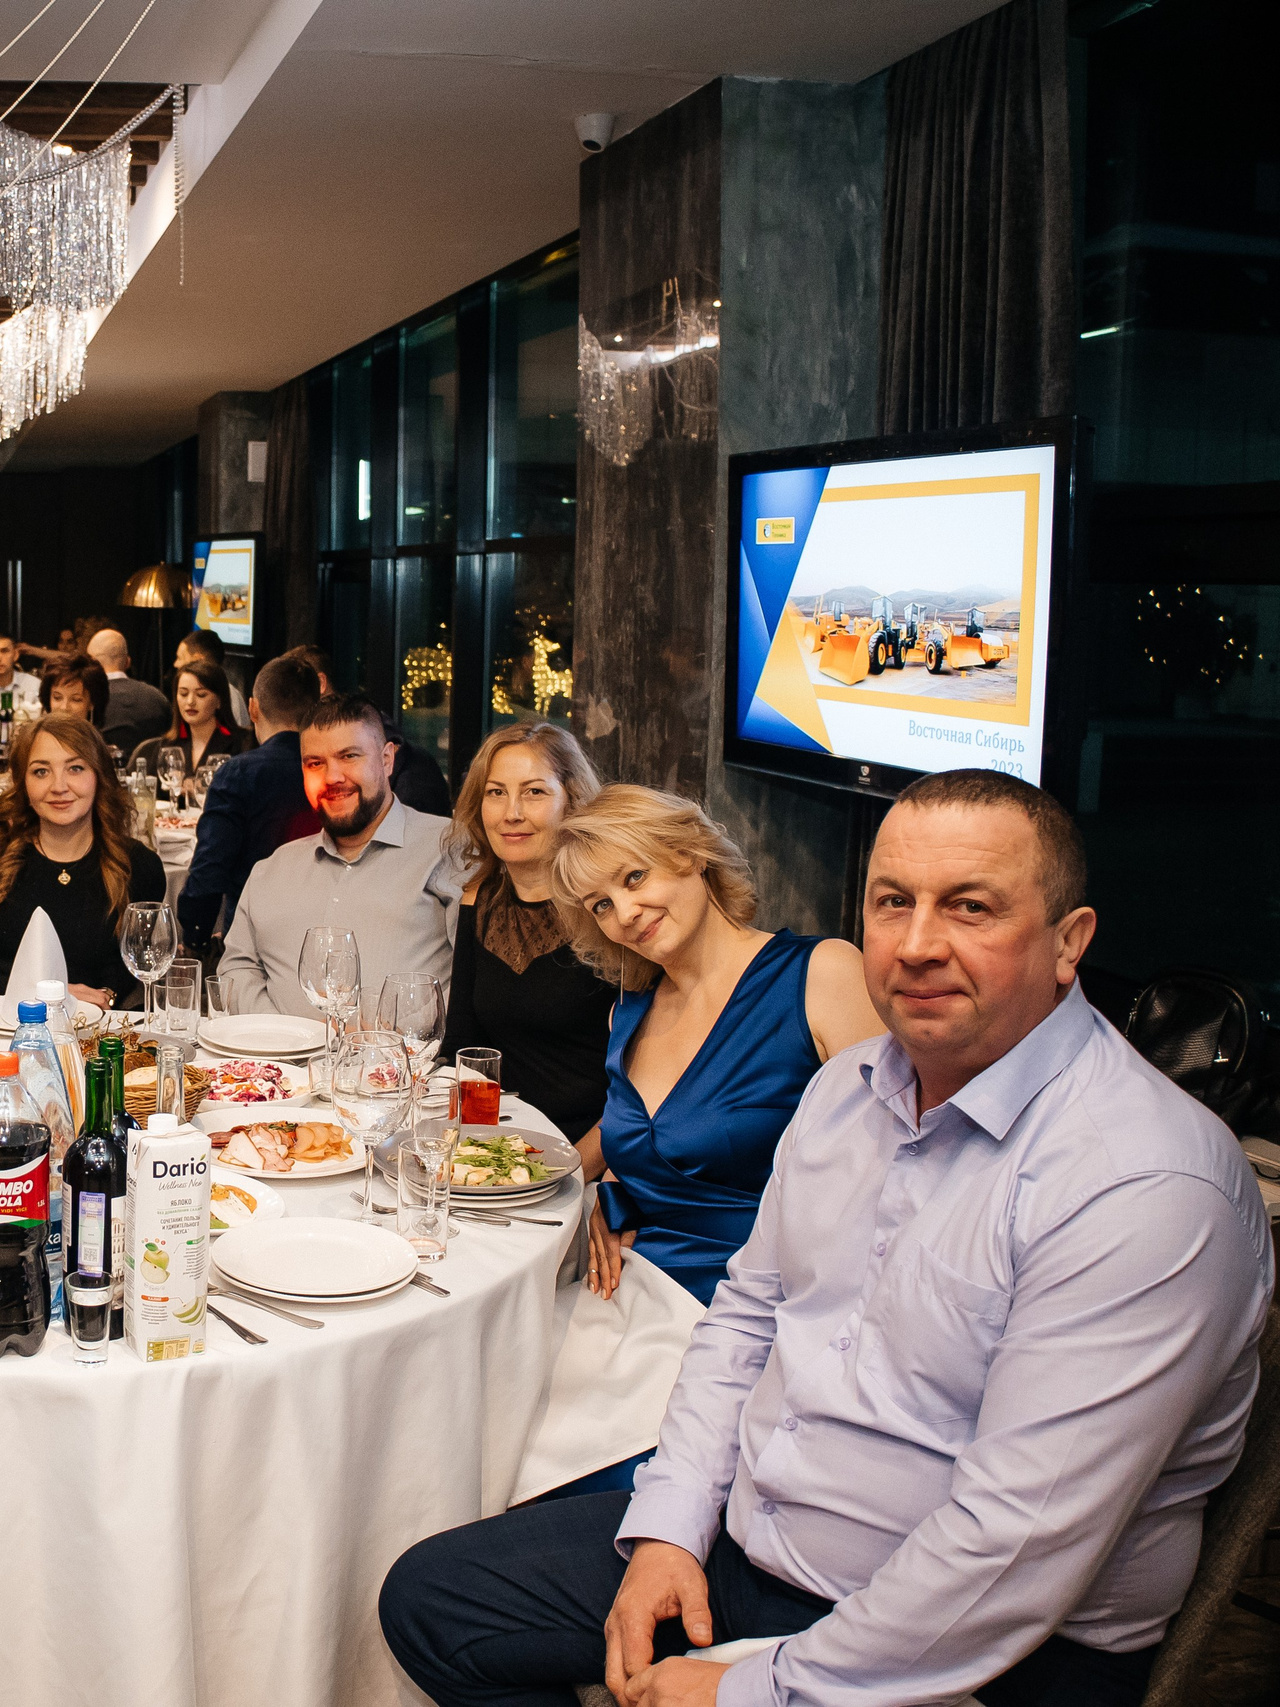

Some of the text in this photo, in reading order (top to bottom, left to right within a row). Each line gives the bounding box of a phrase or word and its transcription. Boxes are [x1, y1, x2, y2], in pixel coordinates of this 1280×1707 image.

[908, 719, 1025, 756] Восточная Сибирь
[990, 758, 1023, 780] 2023
[158, 1179, 203, 1191] Wellness Neo
[170, 1198, 192, 1207] ЯБЛОКО
[166, 1222, 200, 1230] УДИВИТЕЛЬНОГО
